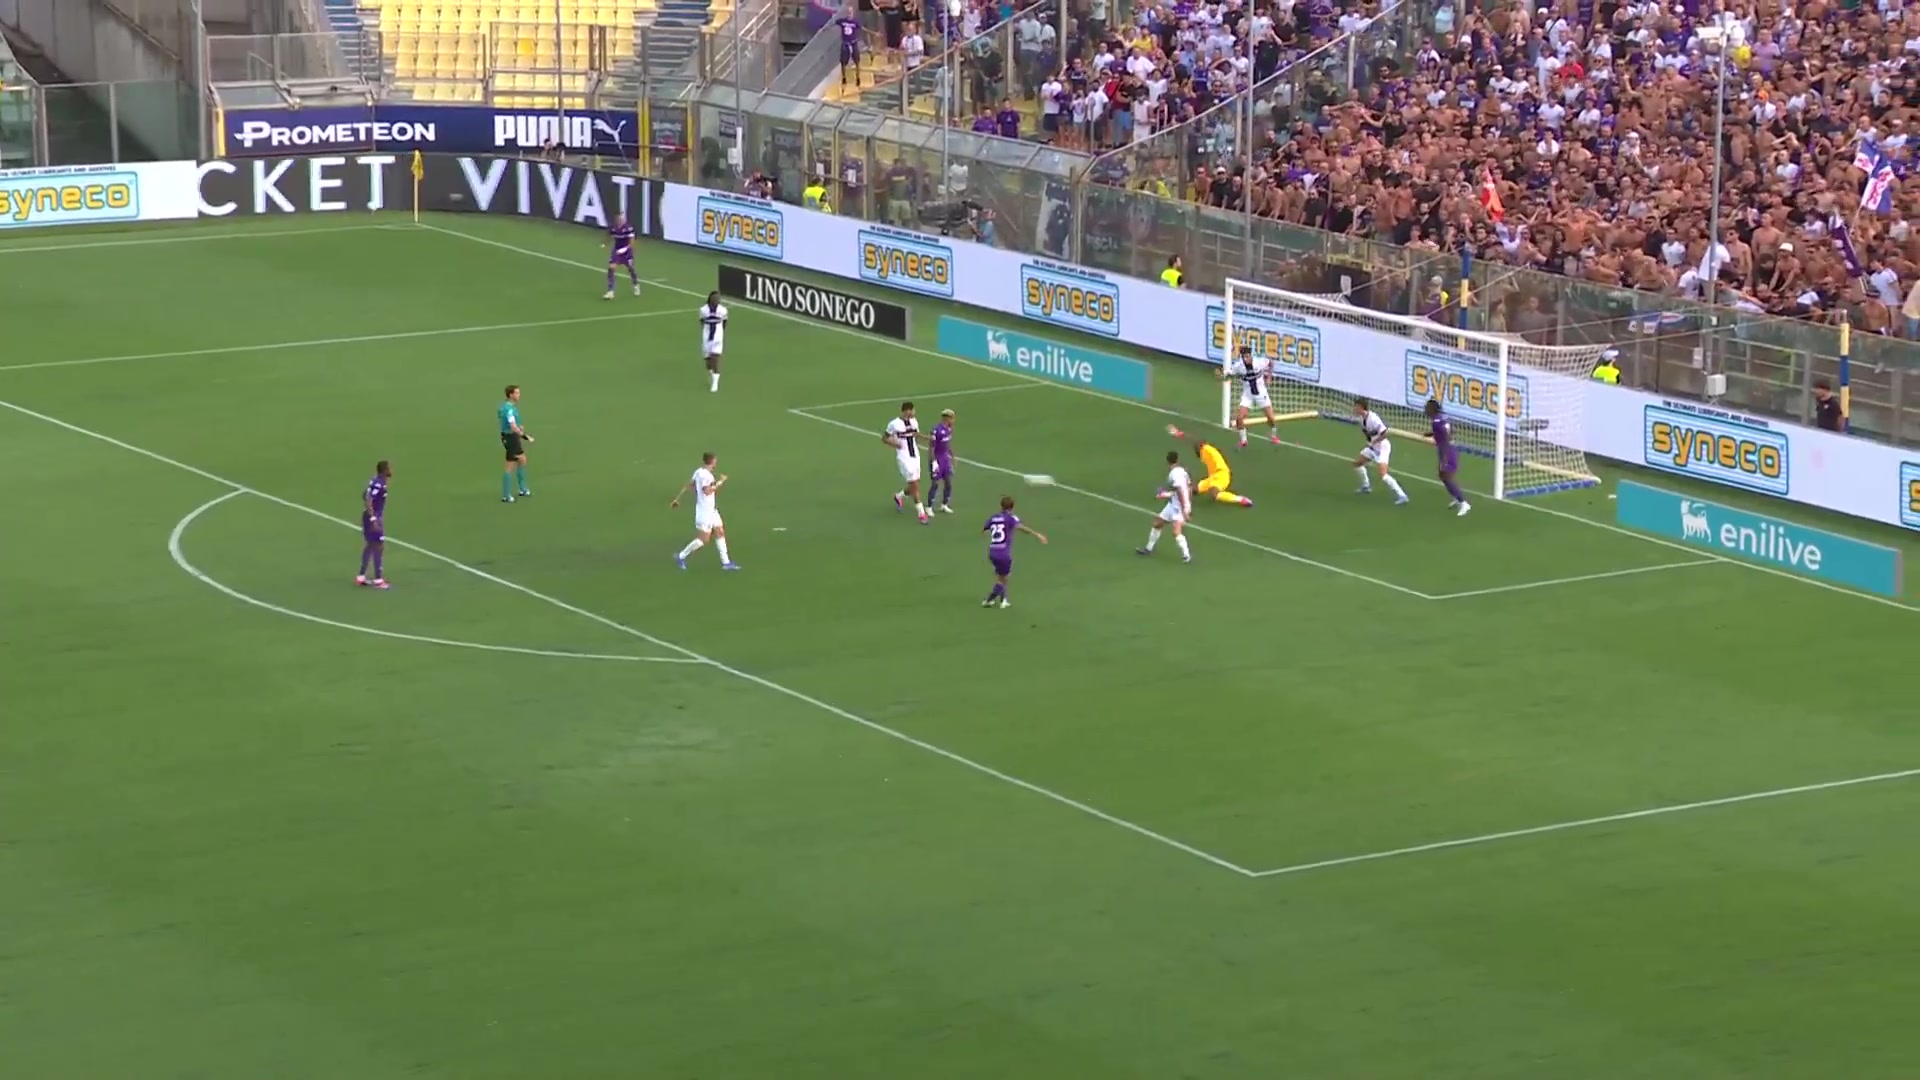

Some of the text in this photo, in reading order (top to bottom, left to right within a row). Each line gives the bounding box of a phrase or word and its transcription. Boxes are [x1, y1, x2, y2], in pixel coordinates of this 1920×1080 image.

[234, 120, 436, 148] PROMETEON
[493, 115, 592, 148] PUMA
[702, 208, 779, 247] syneco
[863, 243, 948, 284] syneco
[744, 273, 875, 329] LINO SONEGO
[1026, 277, 1114, 323] syneco
[1016, 343, 1093, 384] enilive
[1212, 320, 1315, 368] syneco
[1412, 365, 1522, 418] syneco
[1652, 421, 1780, 478] syneco
[990, 523, 1006, 543] 23
[1719, 521, 1822, 571] enilive
